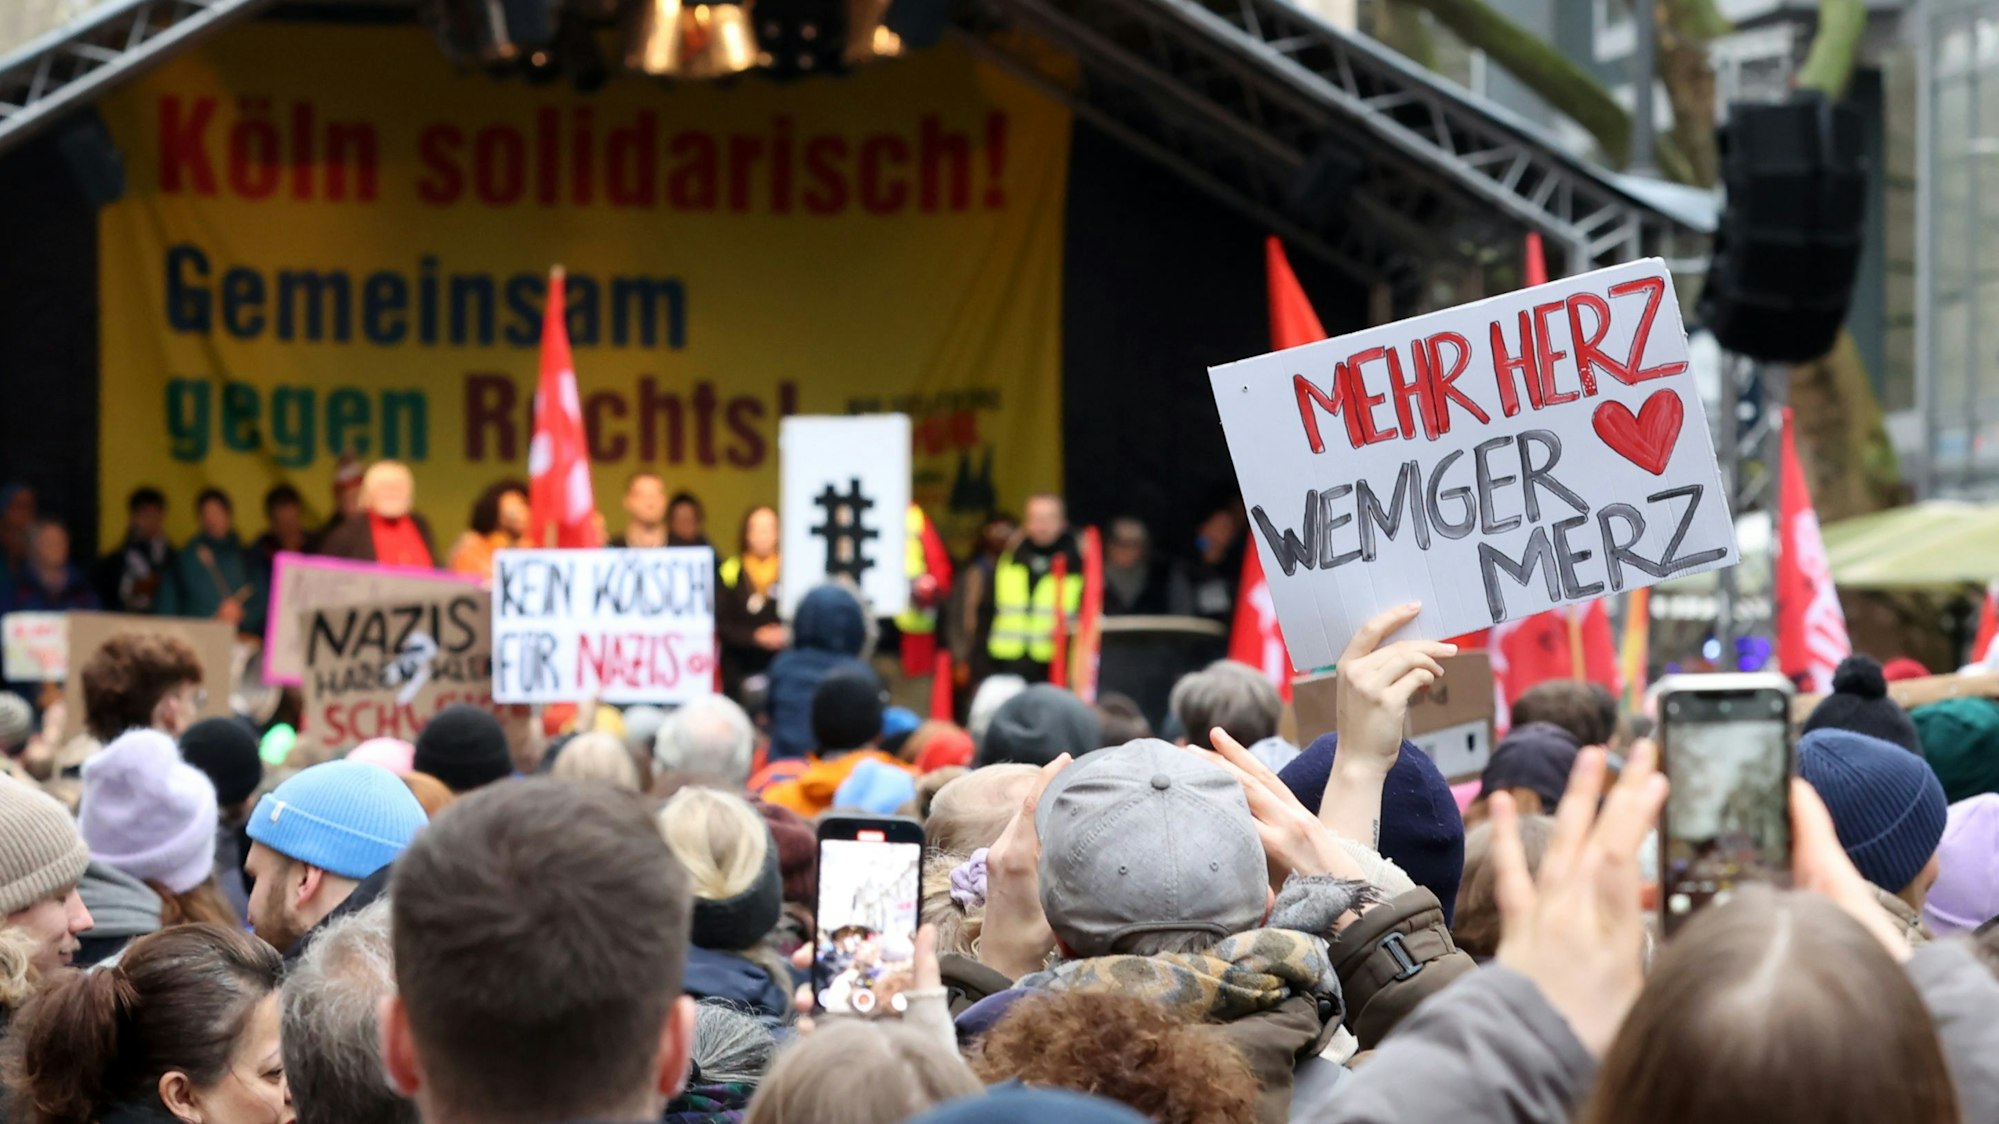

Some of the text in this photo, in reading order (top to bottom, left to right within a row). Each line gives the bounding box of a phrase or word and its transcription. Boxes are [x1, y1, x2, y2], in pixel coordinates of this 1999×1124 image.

[157, 95, 1009, 214] Köln solidarisch!
[163, 245, 689, 350] Gemeinsam
[1293, 276, 1689, 454] MEHR HERZ
[164, 375, 429, 470] gegen
[1251, 429, 1590, 576] WENIGER
[1477, 484, 1728, 623] MERZ
[307, 597, 479, 667] NAZIS
[499, 558, 574, 617] KEIN
[499, 630, 685, 693] FÜR NAZIS
